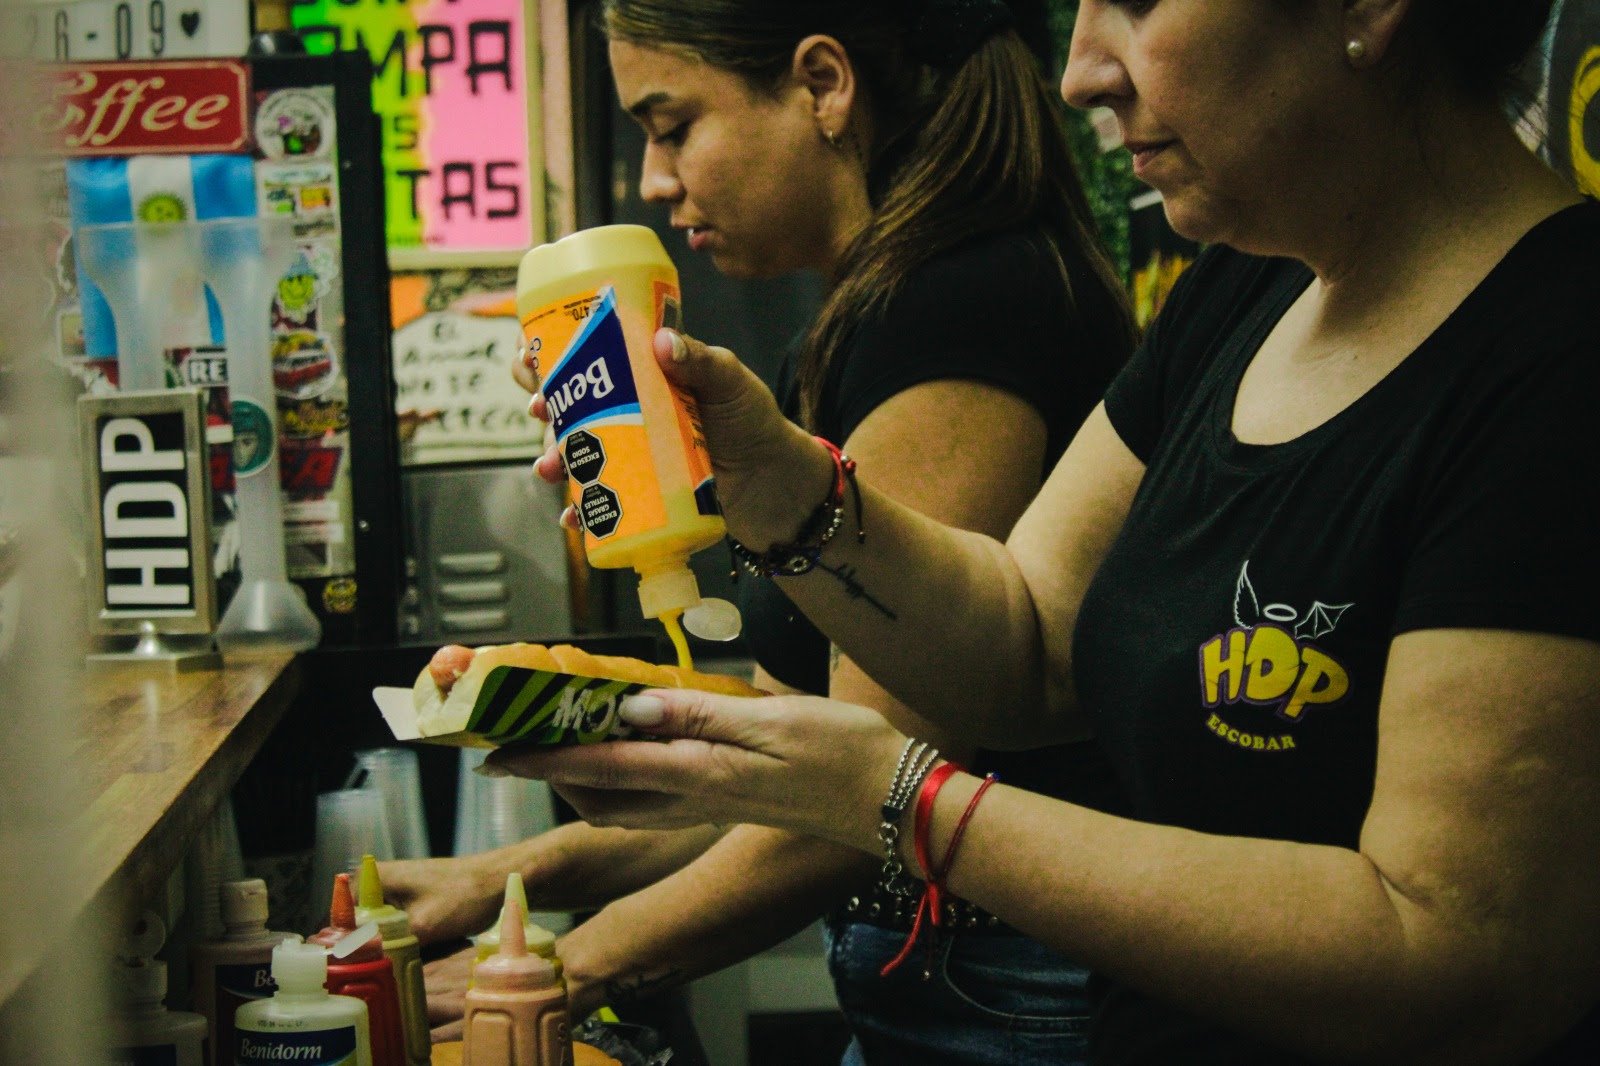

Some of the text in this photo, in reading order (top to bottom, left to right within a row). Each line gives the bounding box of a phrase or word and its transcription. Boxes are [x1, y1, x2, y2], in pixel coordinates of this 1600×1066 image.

[33, 71, 230, 147] offee
[572, 446, 590, 459] SODIO
[576, 452, 600, 466] EXCESO
[100, 417, 190, 605] HDP
[584, 495, 609, 510] TOTALES
[588, 504, 610, 518] GRASAS
[595, 510, 618, 522] EXCESO
[1202, 625, 1349, 719] HDP
[1206, 713, 1296, 750] ESCOBAR
[240, 1037, 323, 1061] Benidorm
